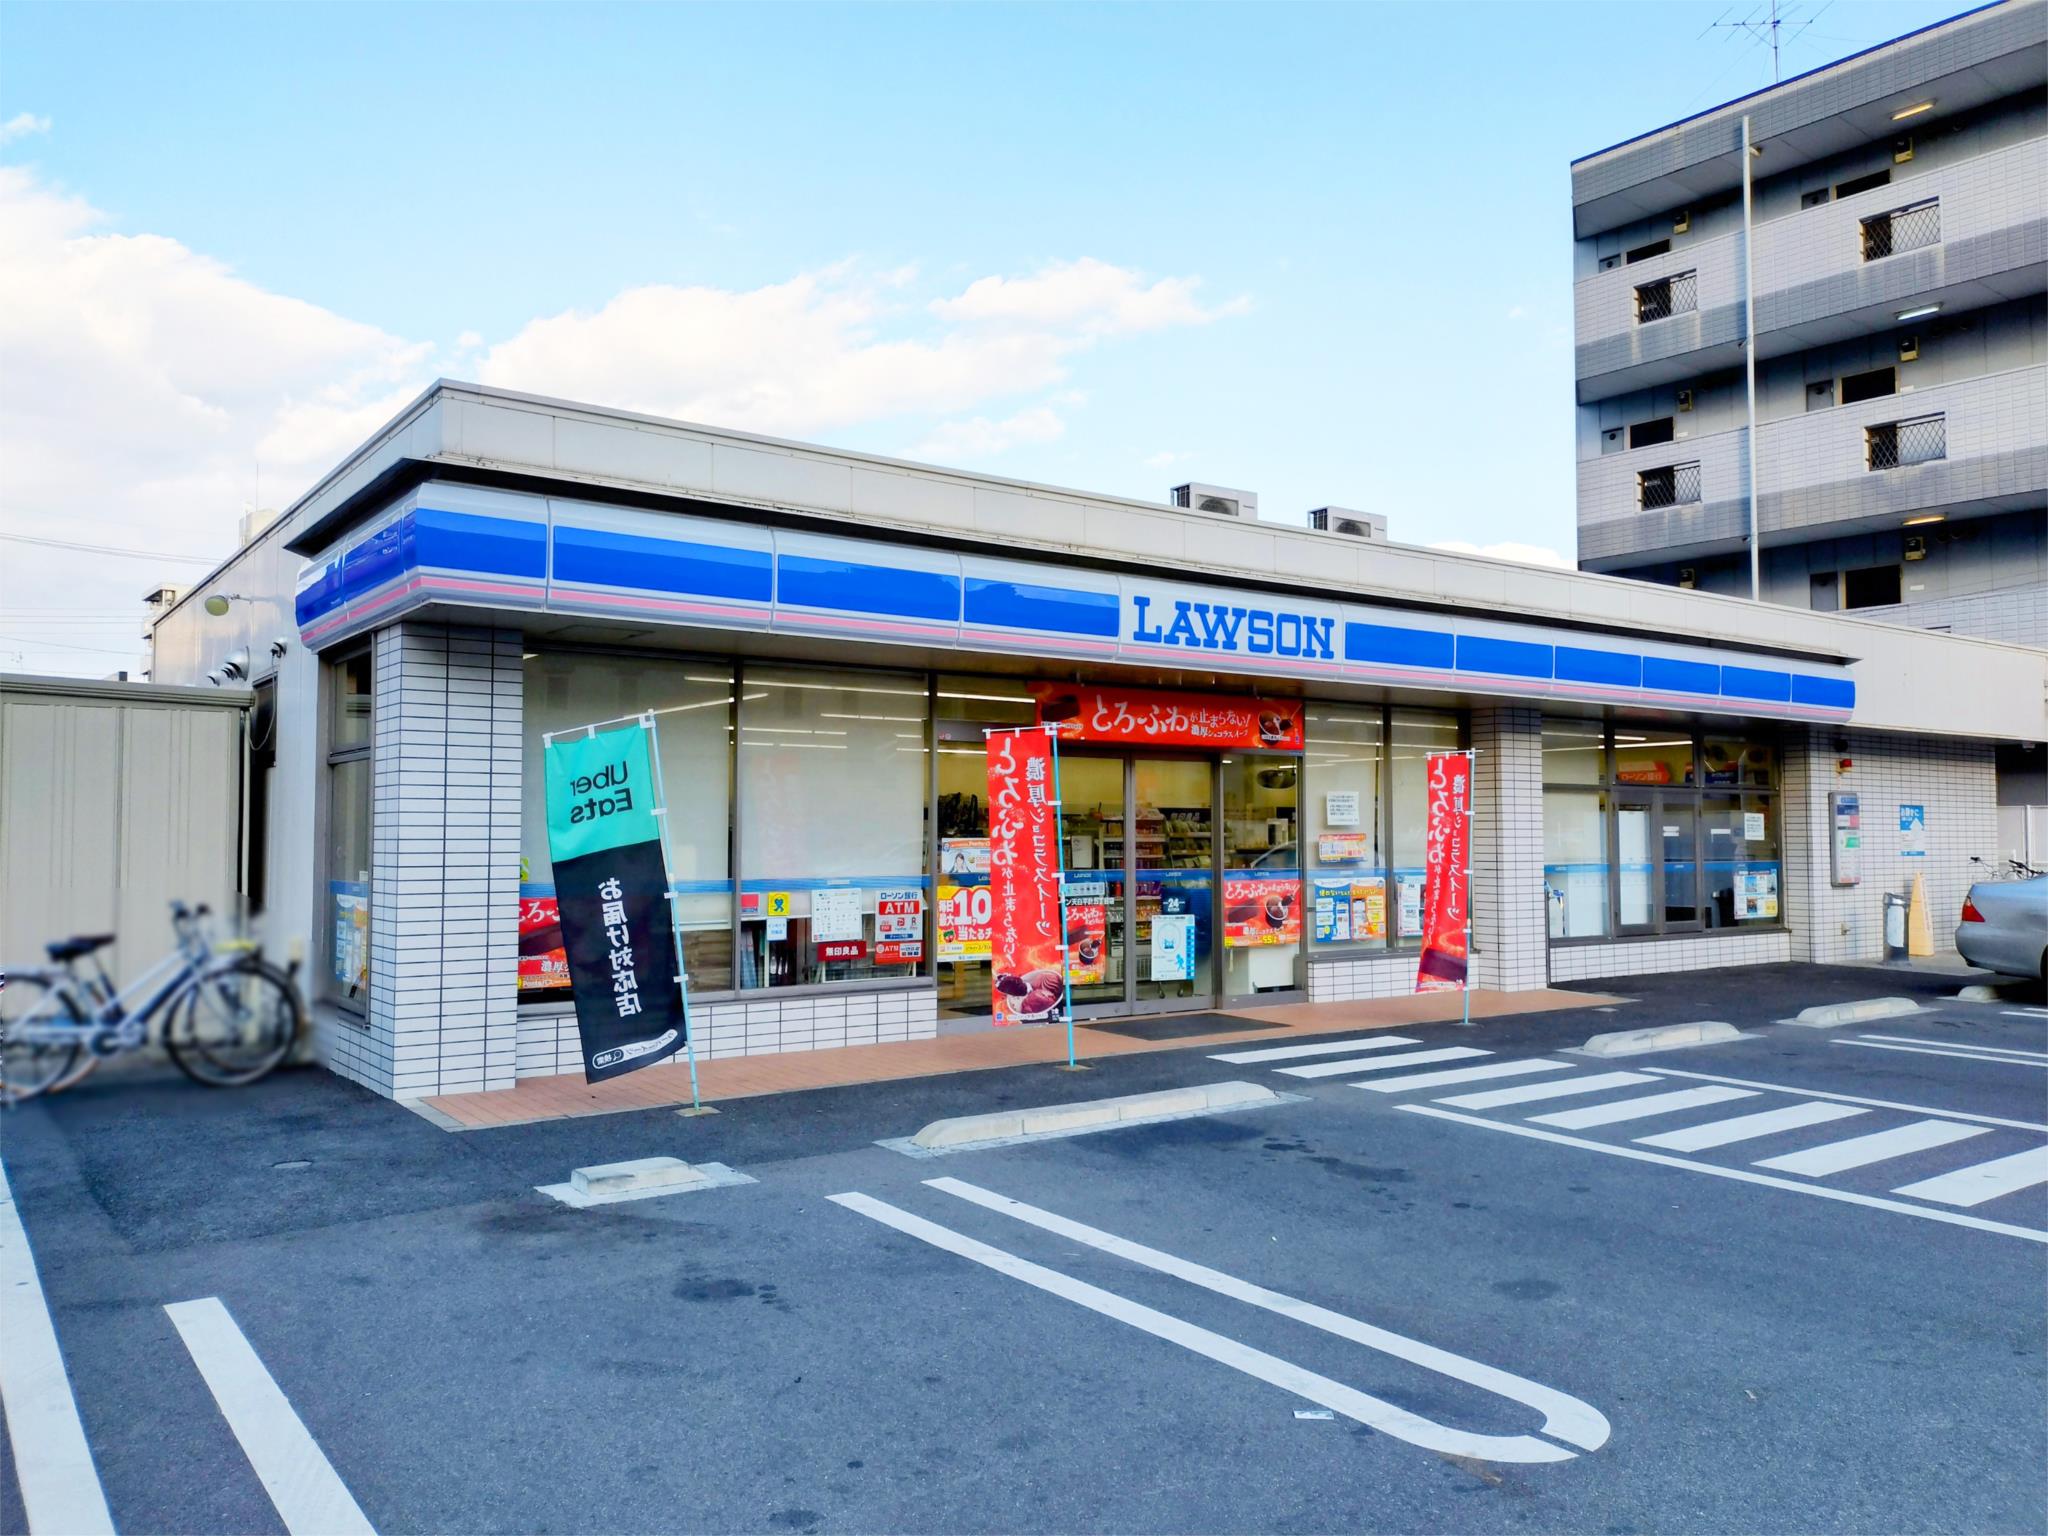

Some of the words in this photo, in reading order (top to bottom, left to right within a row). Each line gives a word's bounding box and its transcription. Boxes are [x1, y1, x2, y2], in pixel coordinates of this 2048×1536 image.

[1133, 595, 1335, 660] LAWSON
[880, 891, 918, 900] ローソン銀行
[885, 902, 915, 914] ATM
[1167, 898, 1179, 908] 24
[825, 945, 859, 957] 無印良品
[884, 945, 899, 953] ATM
